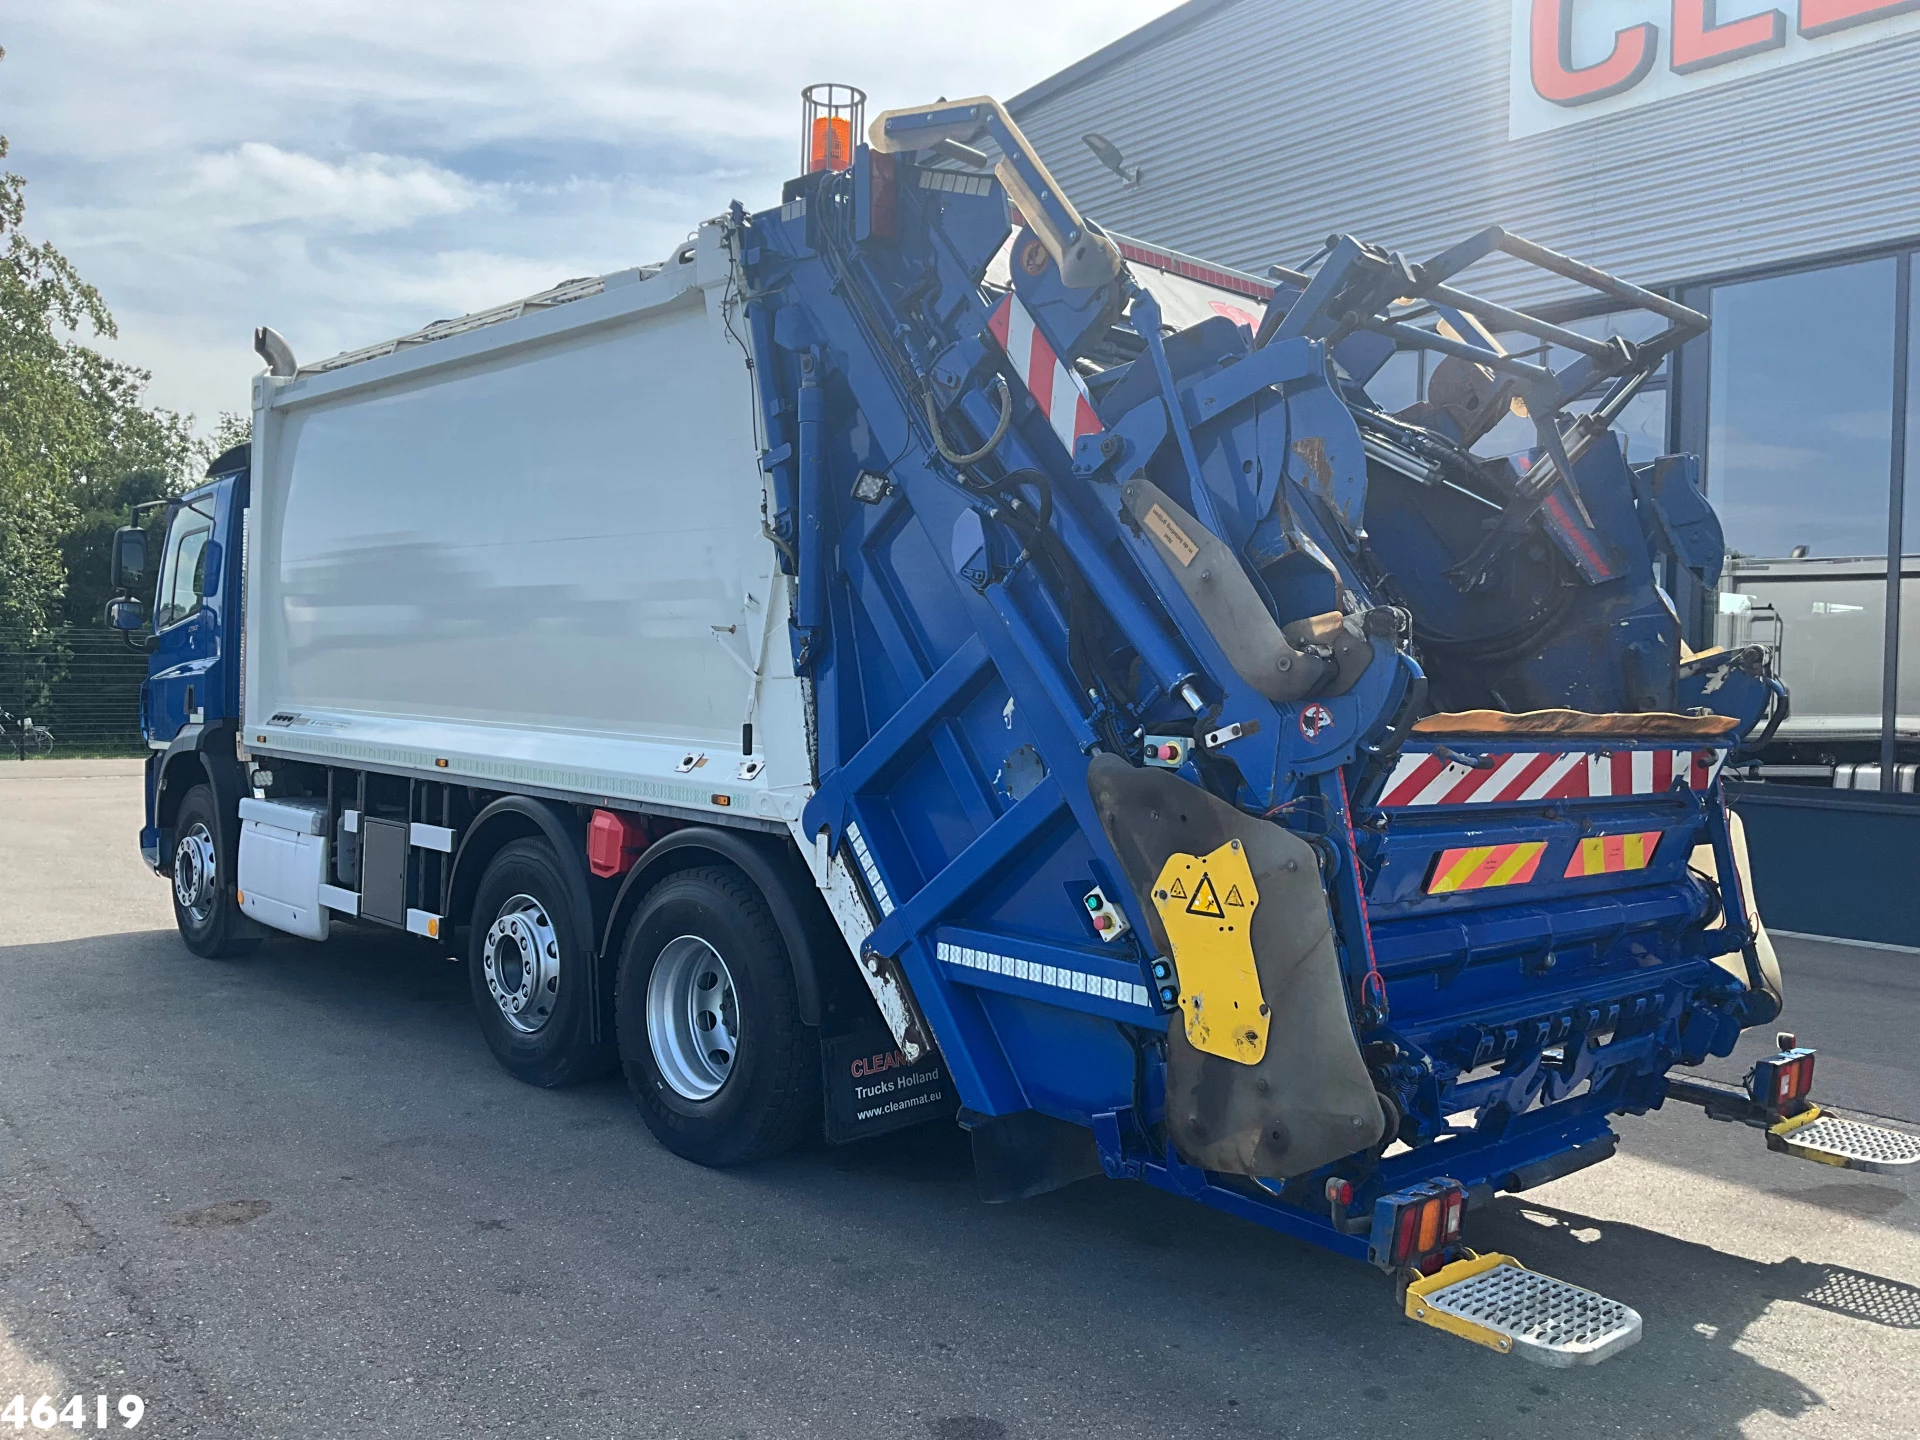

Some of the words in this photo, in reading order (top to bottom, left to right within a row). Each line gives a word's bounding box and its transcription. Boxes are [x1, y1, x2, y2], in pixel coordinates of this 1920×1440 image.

[1530, 0, 1920, 107] CL
[855, 1081, 895, 1099] Trucks
[897, 1068, 939, 1089] Holland
[857, 1092, 942, 1120] www.cleanmat.eu
